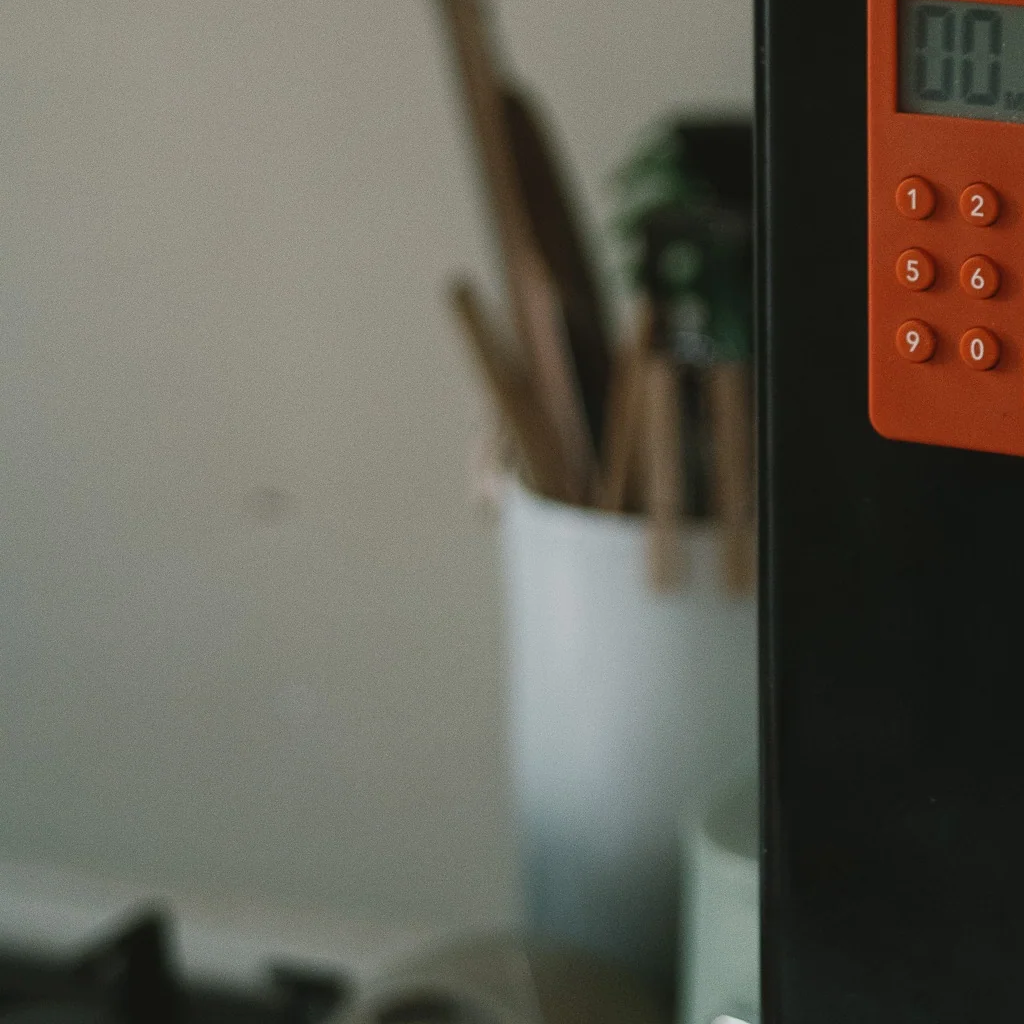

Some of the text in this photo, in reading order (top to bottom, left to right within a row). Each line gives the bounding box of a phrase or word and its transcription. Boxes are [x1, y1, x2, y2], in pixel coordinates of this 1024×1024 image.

[906, 188, 917, 210] 1
[970, 194, 984, 217] 2
[906, 259, 920, 282] 5
[970, 267, 985, 290] 6
[905, 330, 984, 361] 9 0
